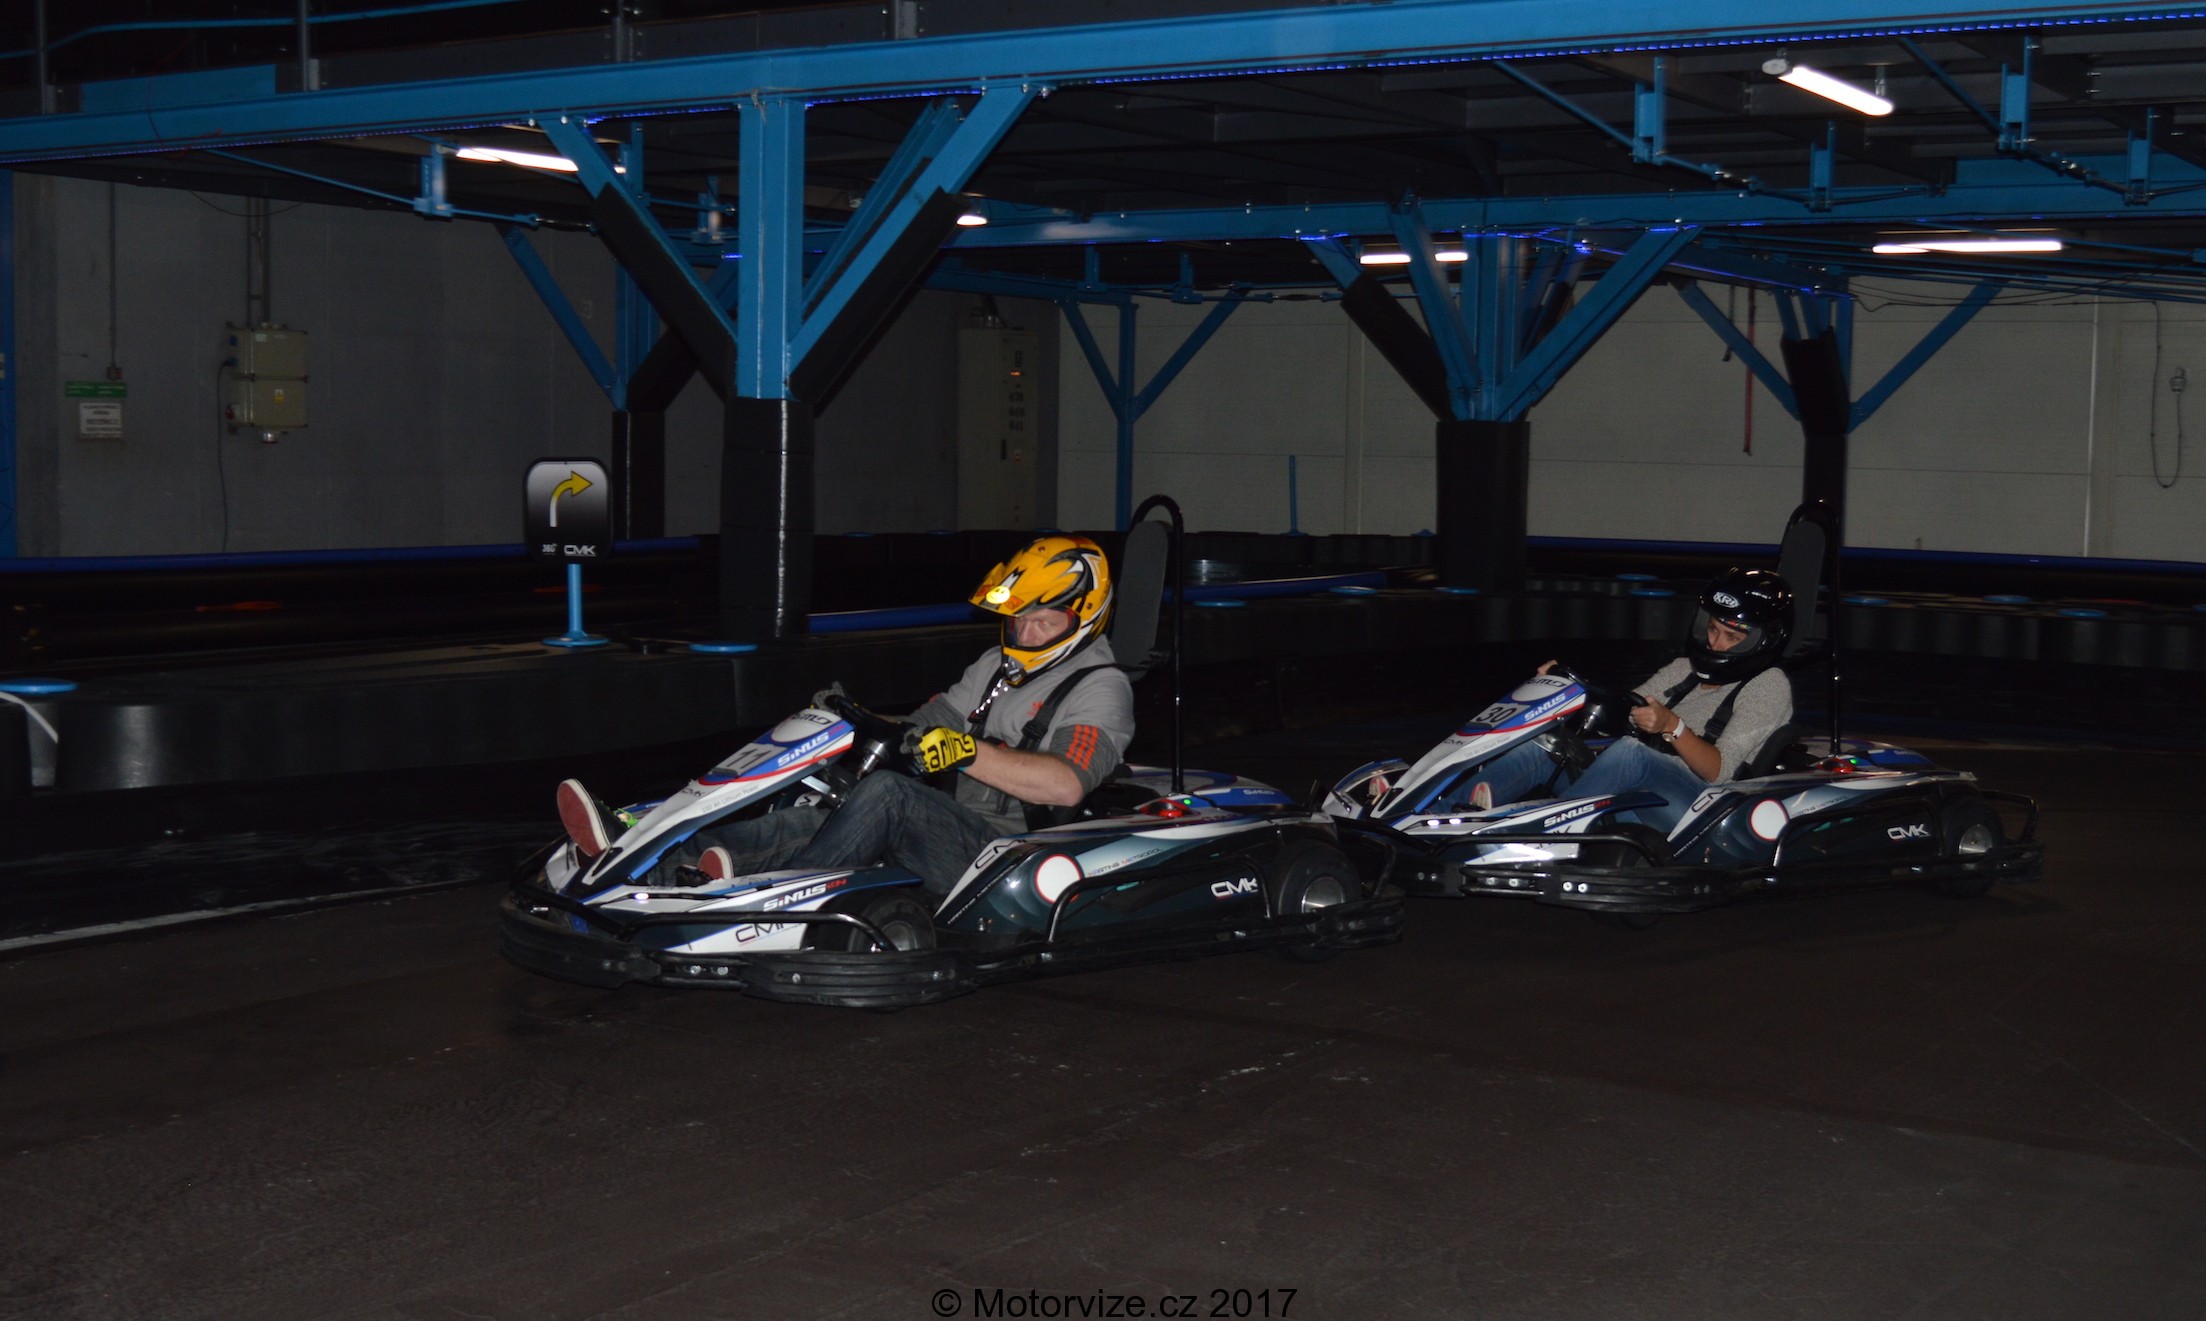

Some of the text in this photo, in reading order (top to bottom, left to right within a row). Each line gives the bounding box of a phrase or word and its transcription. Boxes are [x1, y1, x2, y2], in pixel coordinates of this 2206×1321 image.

[563, 544, 596, 557] CMK
[1475, 706, 1518, 725] 30
[726, 748, 772, 769] 11
[1887, 823, 1931, 840] CMK
[762, 883, 828, 912] SiNUS
[1211, 877, 1259, 898] CMK
